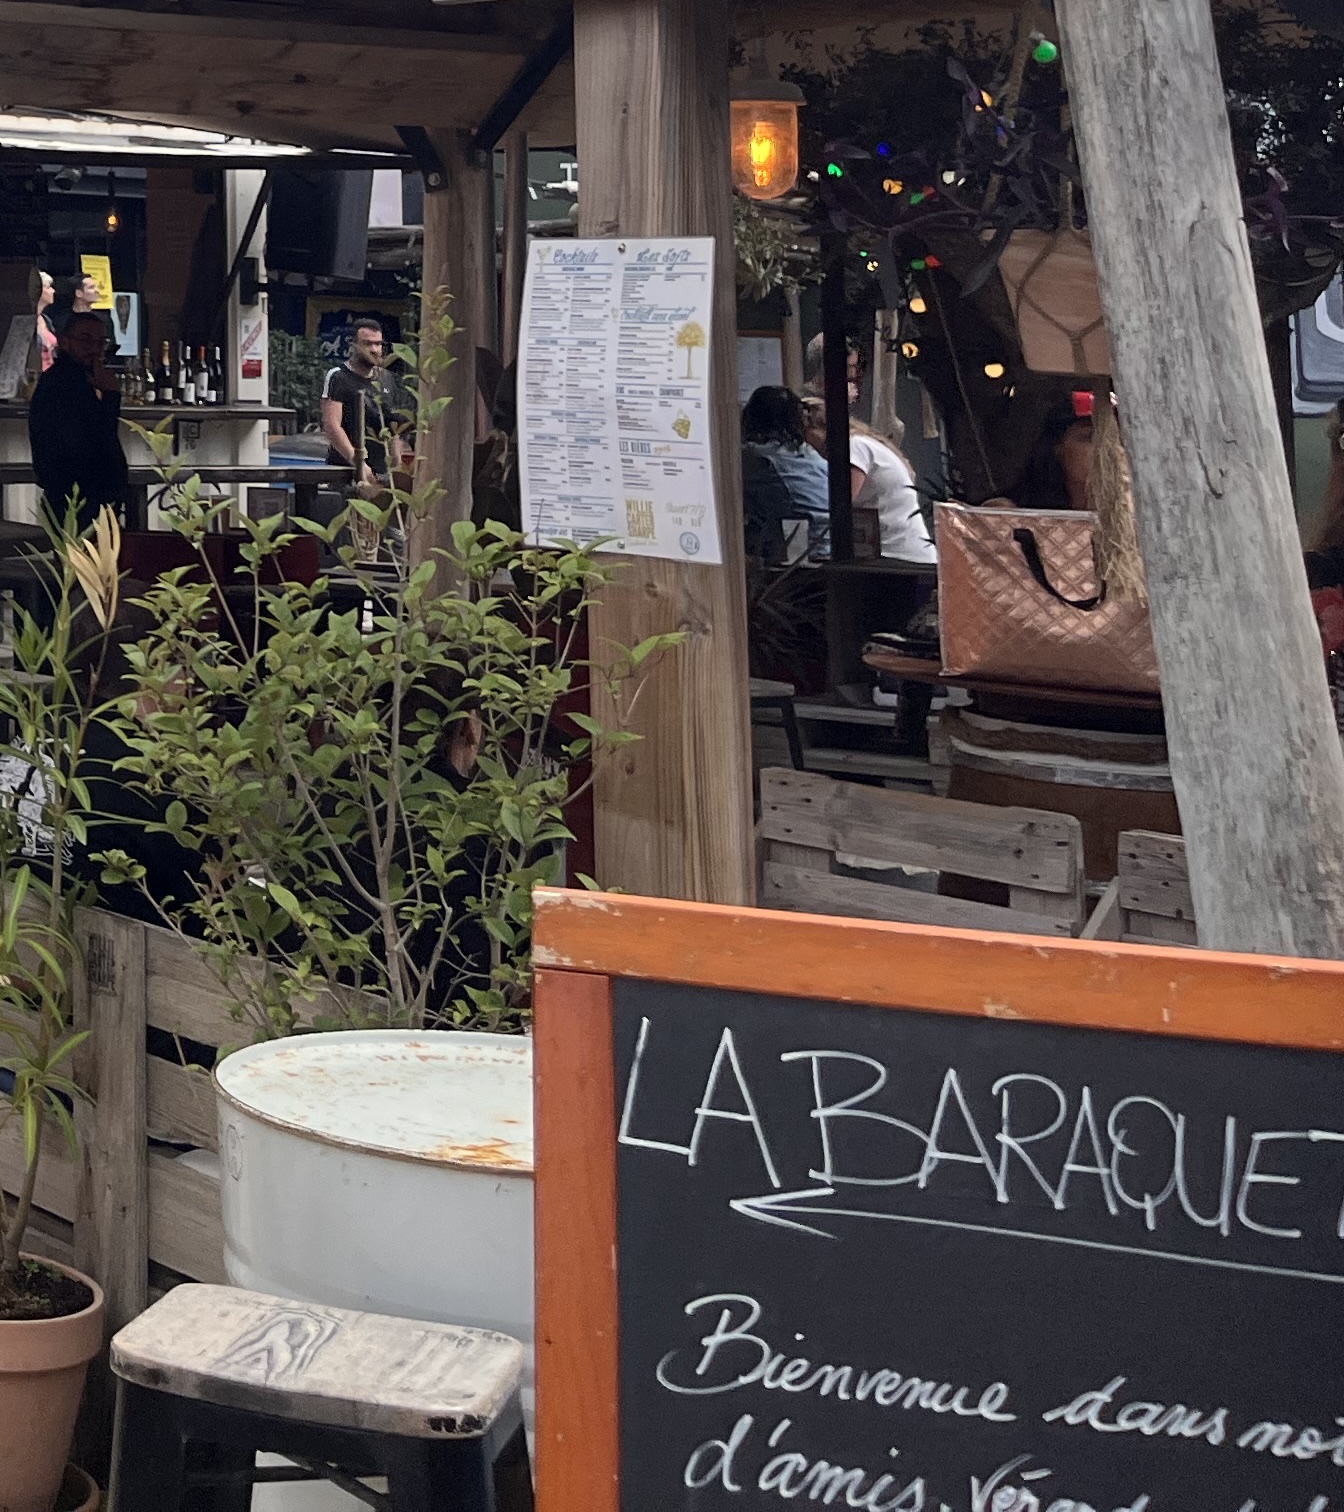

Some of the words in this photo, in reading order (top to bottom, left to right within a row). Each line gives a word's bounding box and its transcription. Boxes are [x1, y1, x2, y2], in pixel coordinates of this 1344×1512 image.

[618, 1016, 782, 1188] LA
[656, 1293, 1017, 1421] Bienvenue
[1042, 1375, 1229, 1445] dans
